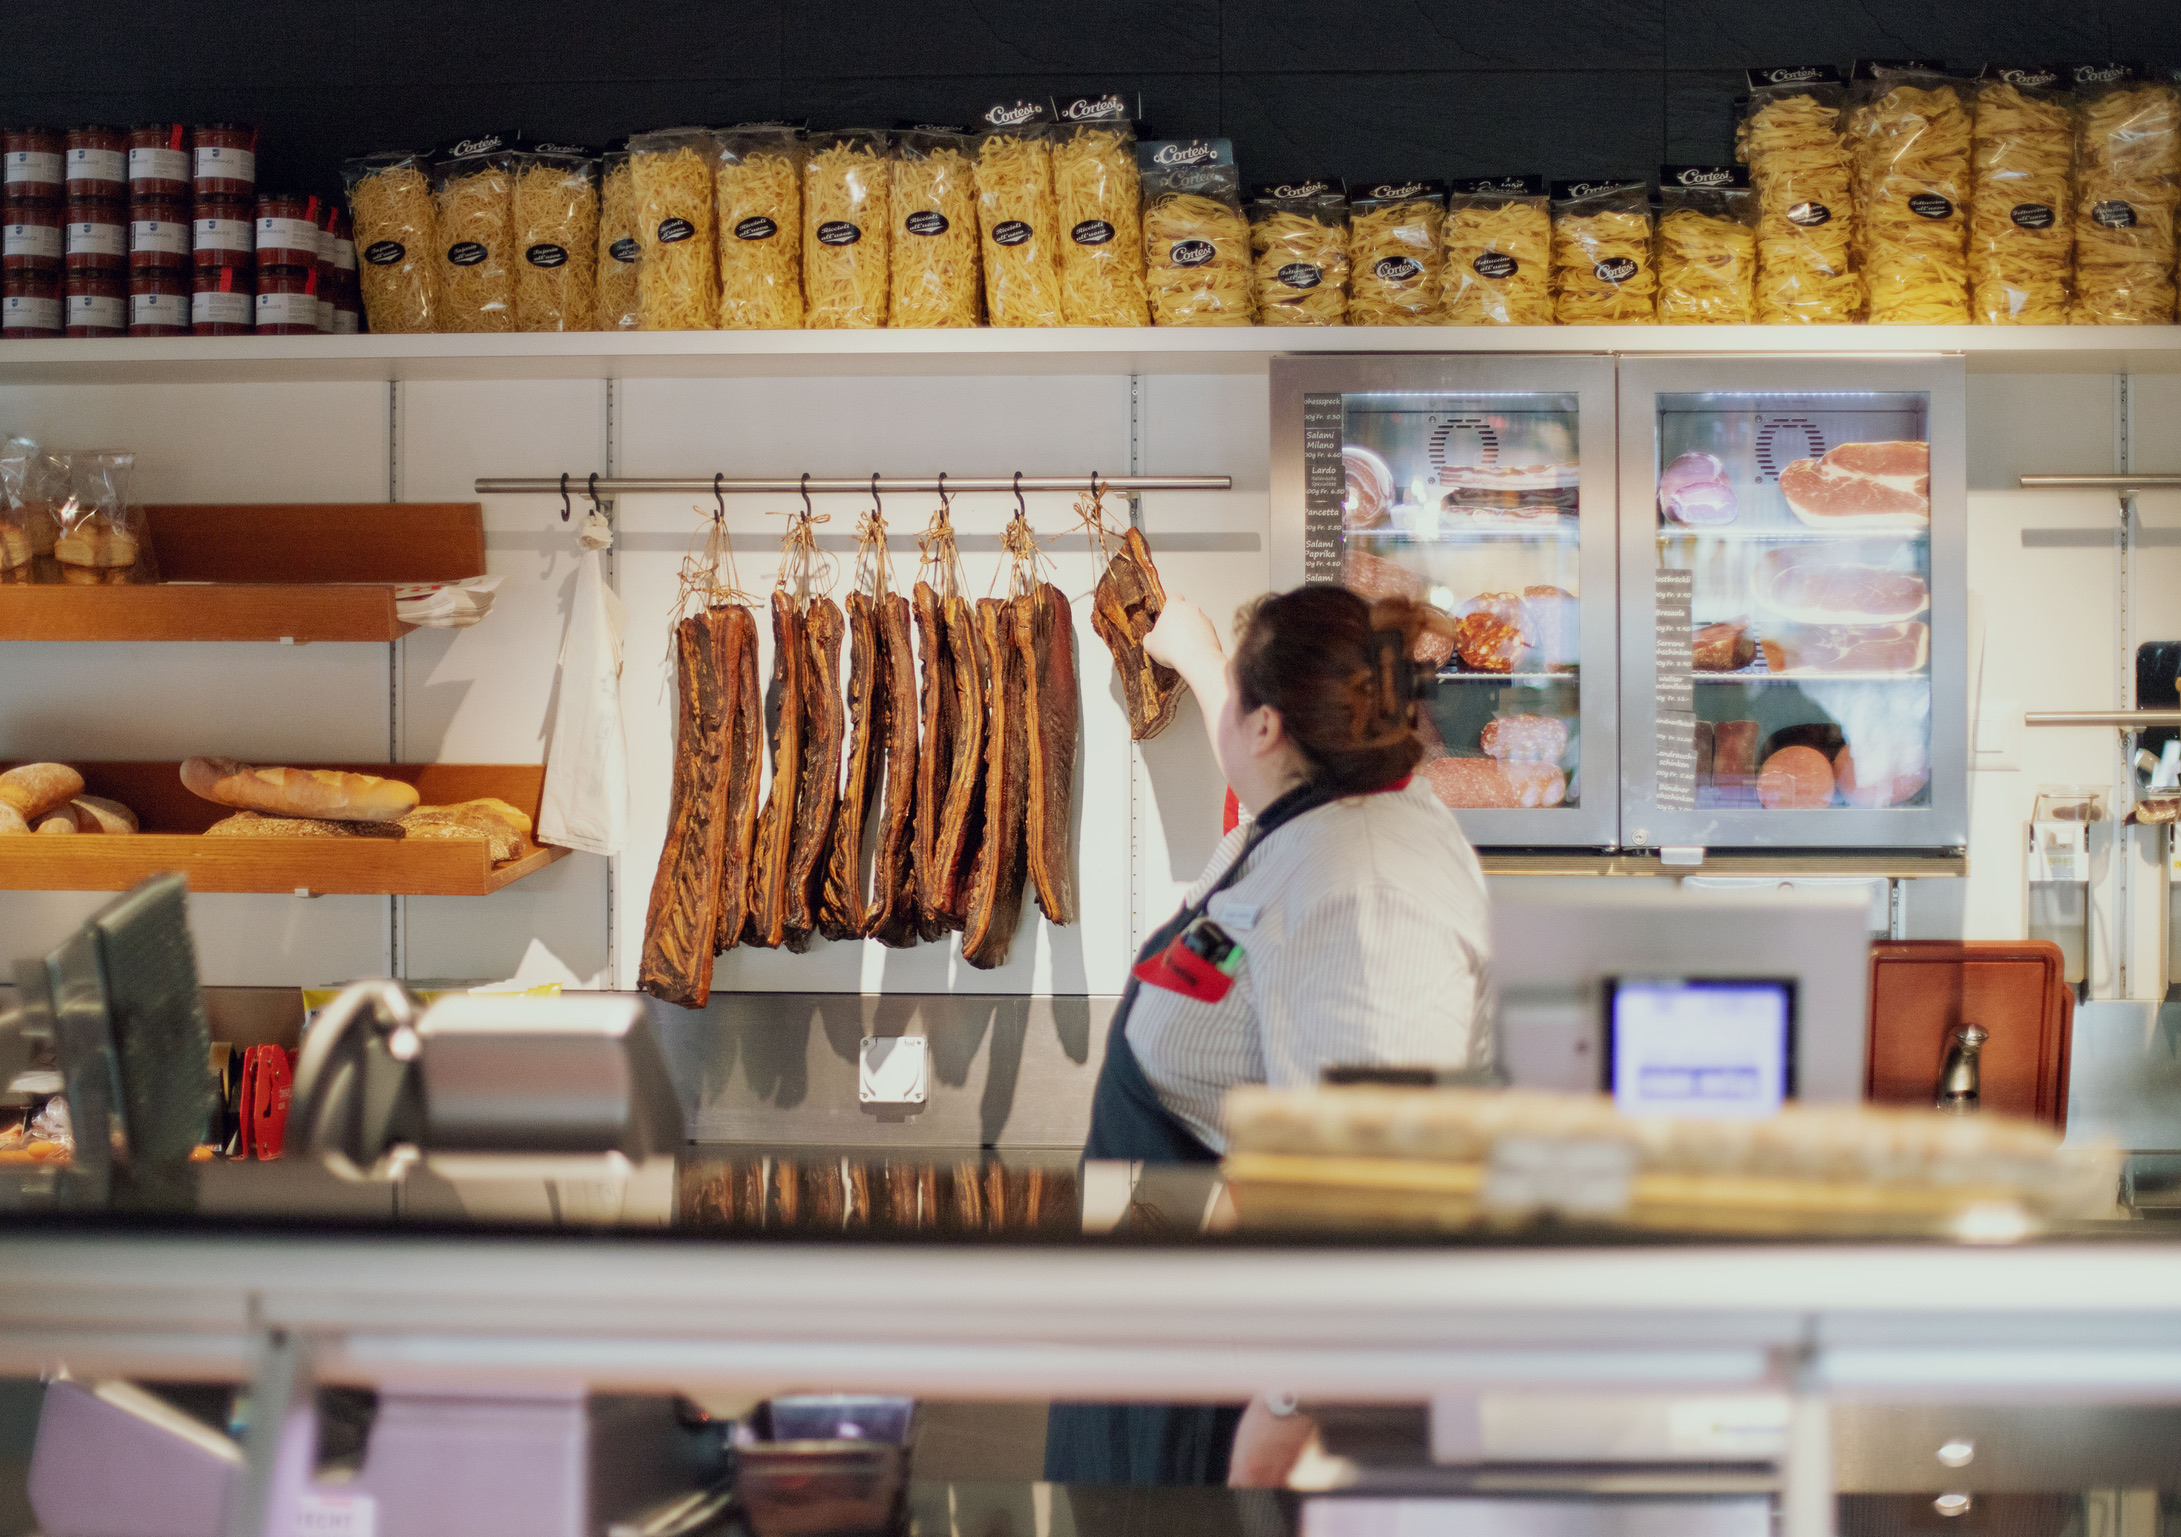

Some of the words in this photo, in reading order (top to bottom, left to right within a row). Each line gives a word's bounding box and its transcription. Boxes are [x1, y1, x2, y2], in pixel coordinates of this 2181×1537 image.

[1770, 68, 1815, 82] Cortesi
[2003, 70, 2055, 85] Cortesi
[990, 103, 1034, 124] Cortesi
[1070, 98, 1118, 119] Cortesi
[454, 136, 501, 156] Cortesi
[1159, 143, 1209, 164] Cortesi
[1682, 170, 1730, 184] Cortesi
[1275, 182, 1321, 198] Cortesi
[1374, 183, 1422, 198] Cortesi
[739, 218, 767, 231] Riccioli
[910, 214, 939, 224] Riccioli
[821, 223, 850, 234] Riccioli
[996, 222, 1021, 235] Riccioli
[1076, 221, 1104, 235] Riccioli
[1172, 245, 1211, 263] Cortesi
[1596, 261, 1635, 280] Cortesi
[1304, 398, 1340, 407] ohessspeck
[1306, 431, 1335, 439] Salami
[1306, 441, 1335, 449] Milano
[1312, 466, 1336, 474] Lardo
[1306, 488, 1319, 496] 00g
[1305, 539, 1334, 548] Salami
[1305, 573, 1334, 582] Salami
[1655, 575, 1692, 583] ostbröckli
[1658, 675, 1684, 683] Walliser
[1656, 717, 1695, 728] ündnerfleisch
[1659, 759, 1690, 768] schinken
[1656, 770, 1669, 778] 00g
[1658, 783, 1690, 793] Bündner
[1656, 792, 1695, 803] ohschinken
